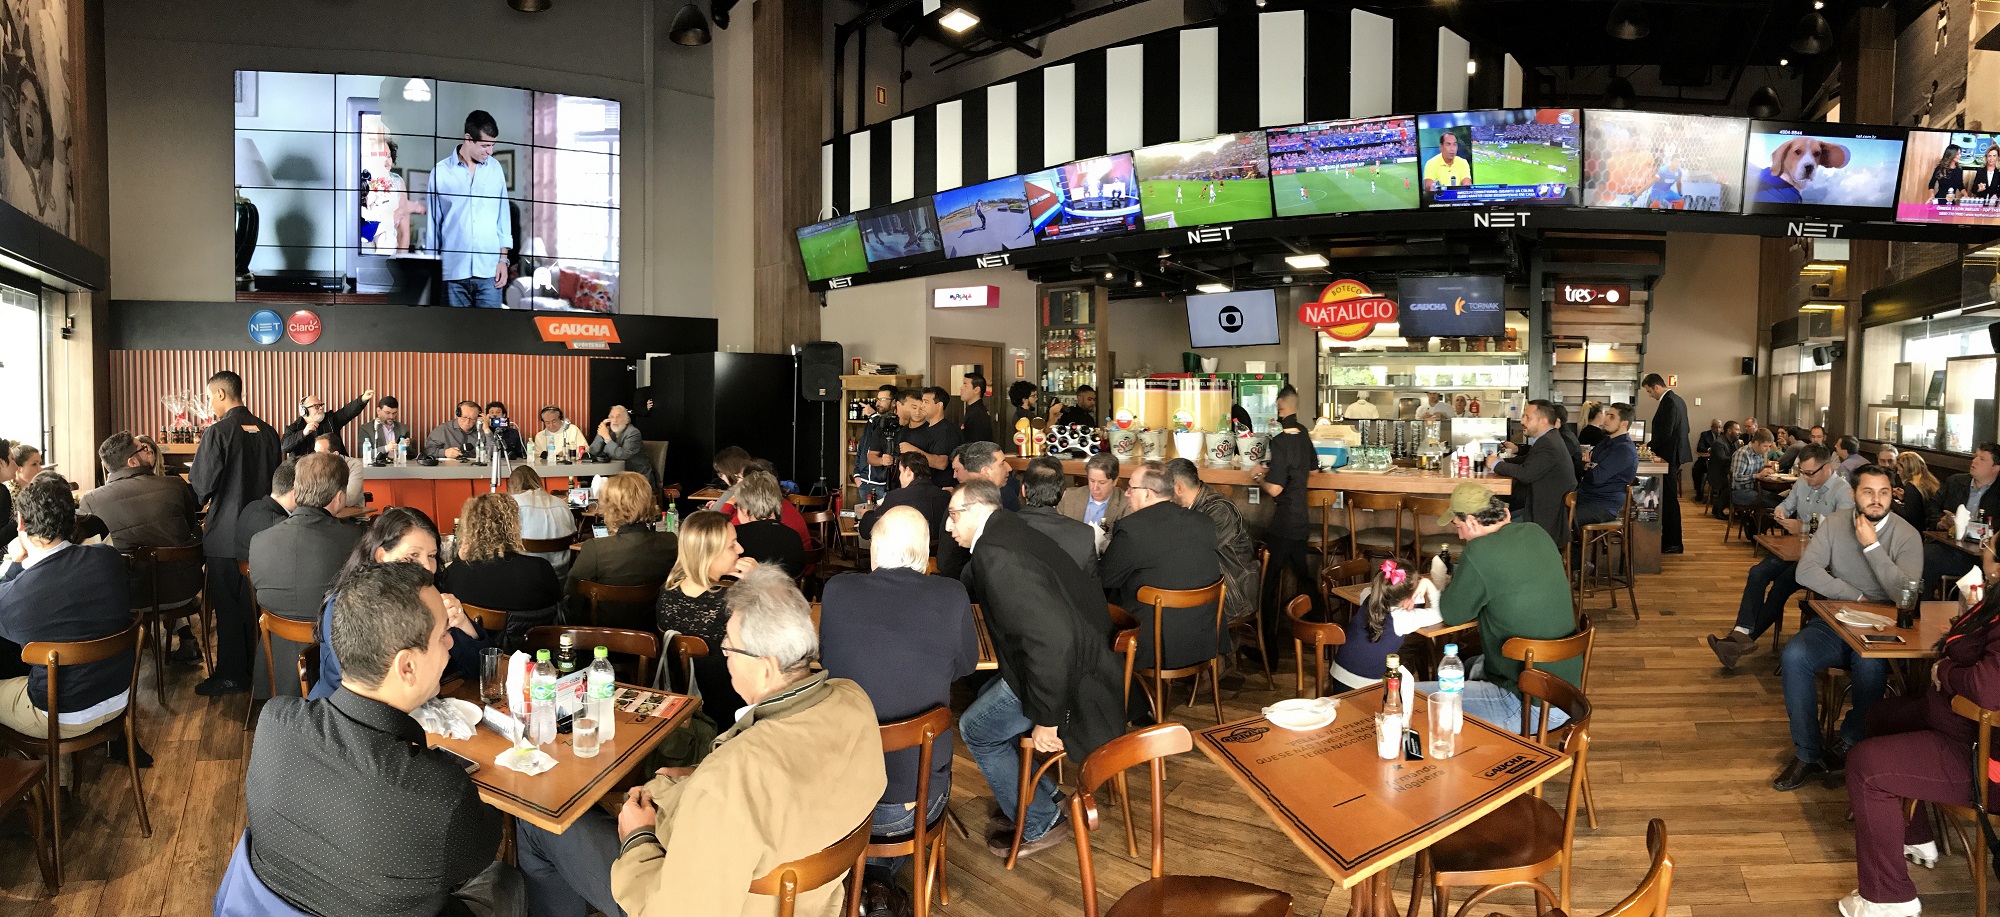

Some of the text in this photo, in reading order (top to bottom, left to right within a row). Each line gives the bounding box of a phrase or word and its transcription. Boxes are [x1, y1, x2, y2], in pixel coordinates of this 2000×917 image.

[1473, 212, 1531, 228] NET
[1187, 226, 1233, 244] NET
[1787, 222, 1844, 238] NET
[976, 253, 1010, 269] NET
[828, 276, 852, 289] NET
[1331, 285, 1363, 296] BOTECO
[1305, 301, 1393, 323] NATALICIO
[1409, 303, 1448, 311] GAUCHA
[1467, 302, 1500, 310] TORNAK
[250, 322, 281, 332] NET
[289, 321, 317, 332] Claro
[548, 323, 611, 337] GAUCHA
[1484, 755, 1527, 778] GAUCHA
[1394, 769, 1446, 793] Nogueira
